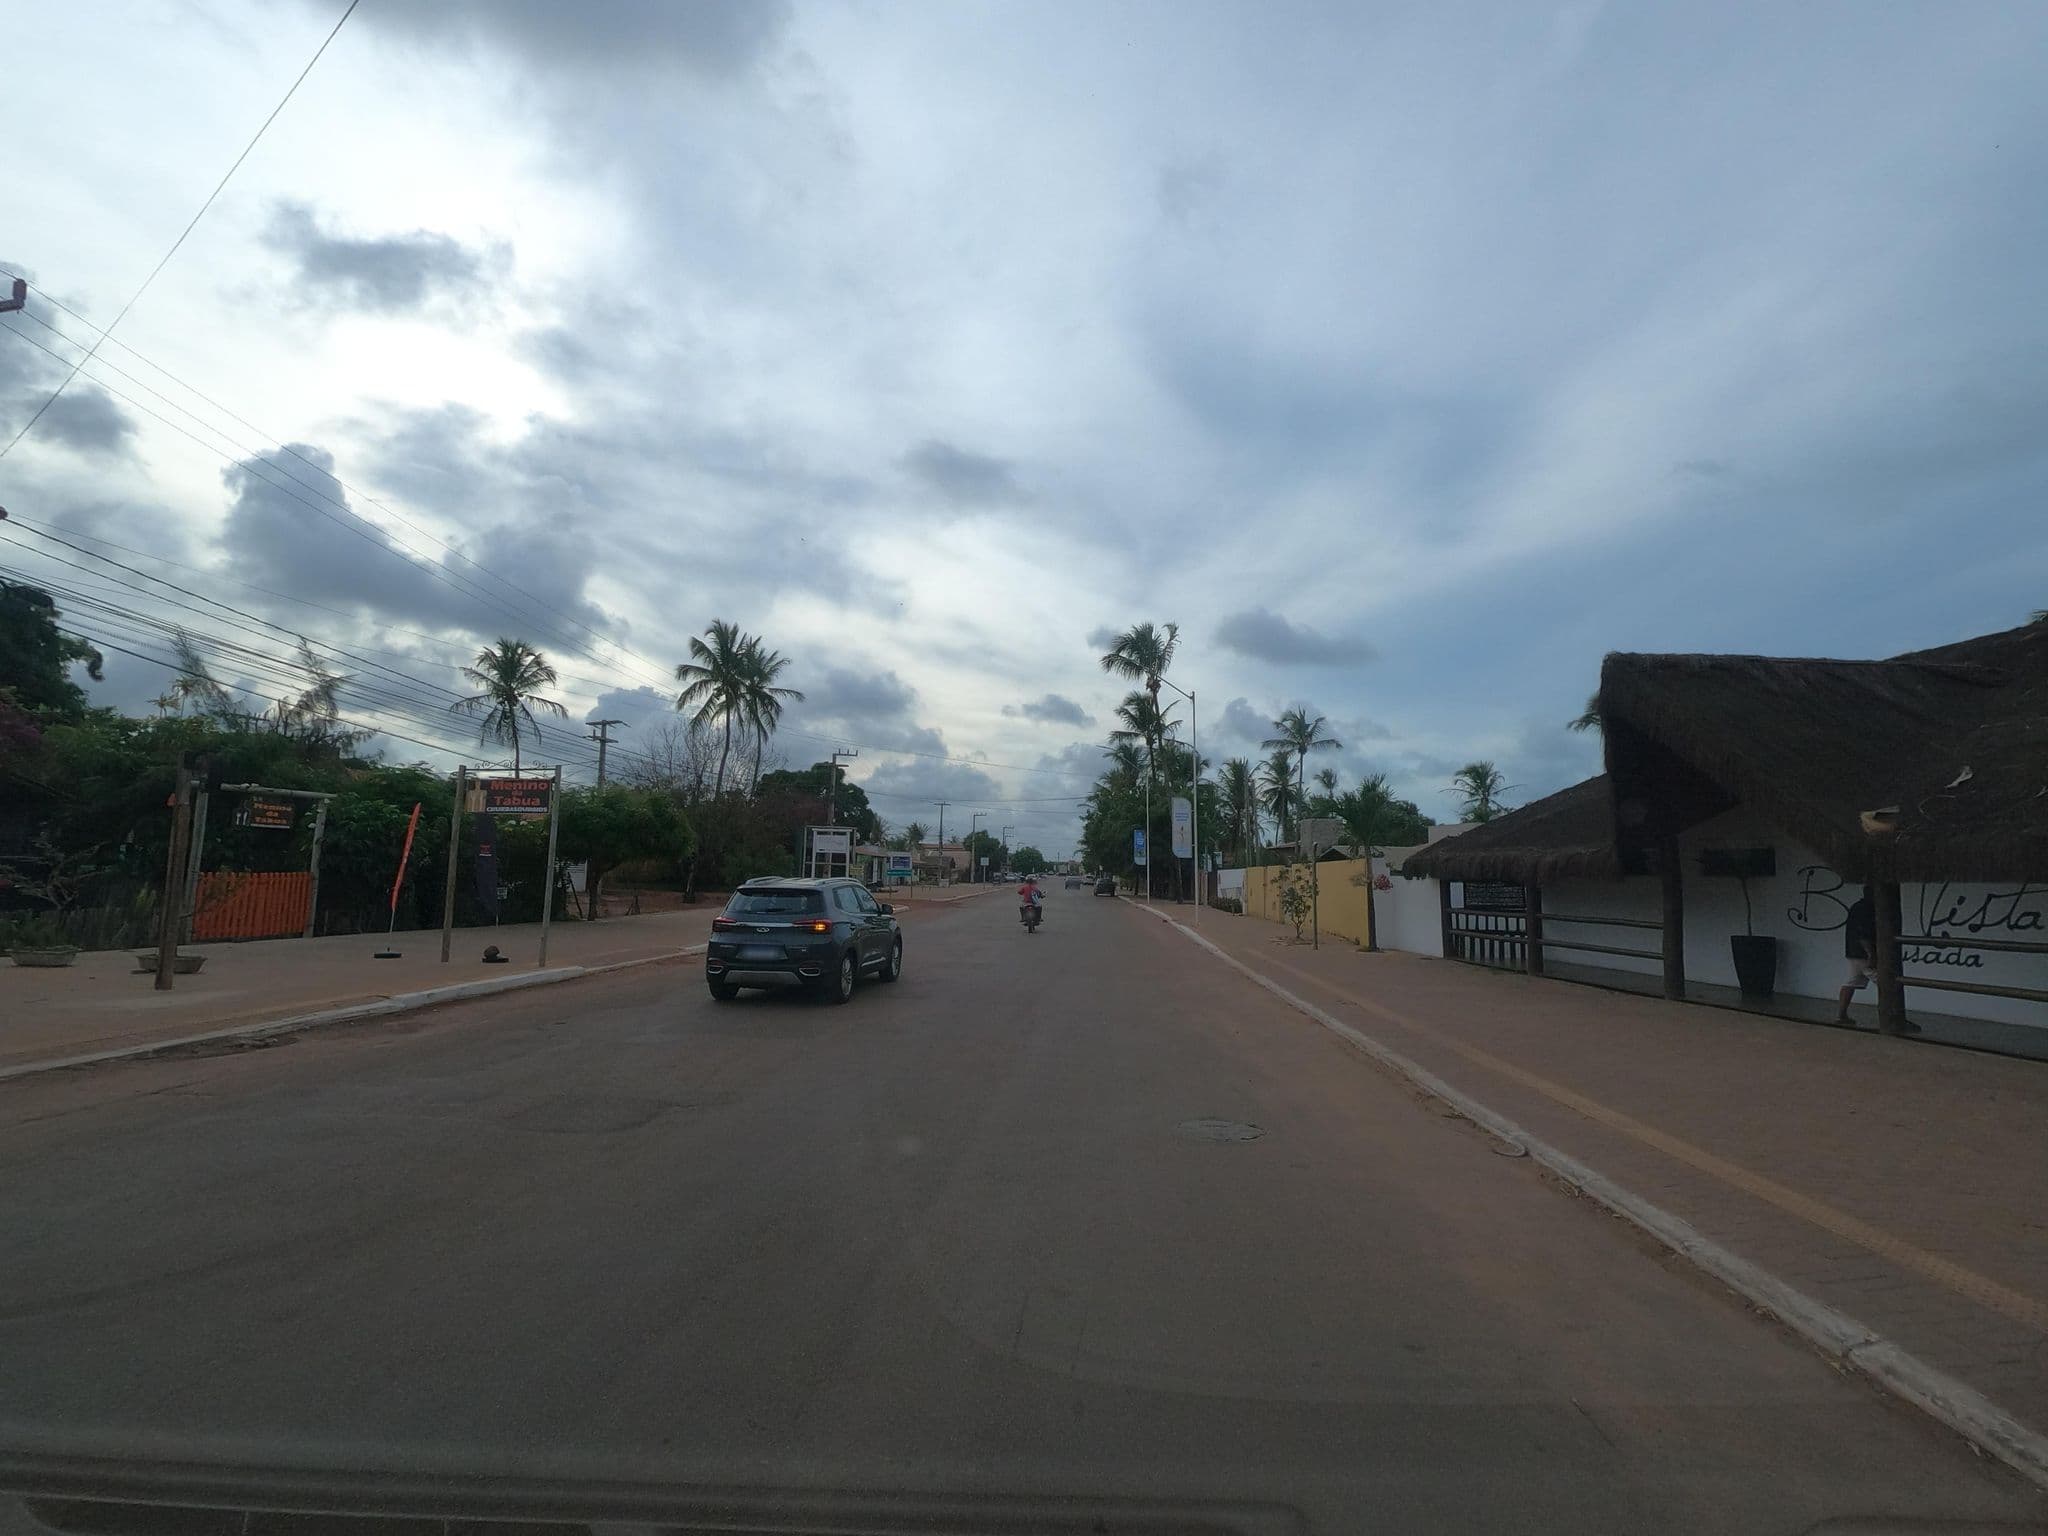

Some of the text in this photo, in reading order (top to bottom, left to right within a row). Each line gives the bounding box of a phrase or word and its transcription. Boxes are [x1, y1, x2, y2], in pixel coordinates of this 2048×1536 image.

[491, 780, 548, 791] Menino
[494, 796, 541, 806] Tabua
[1920, 880, 2048, 937] Vista
